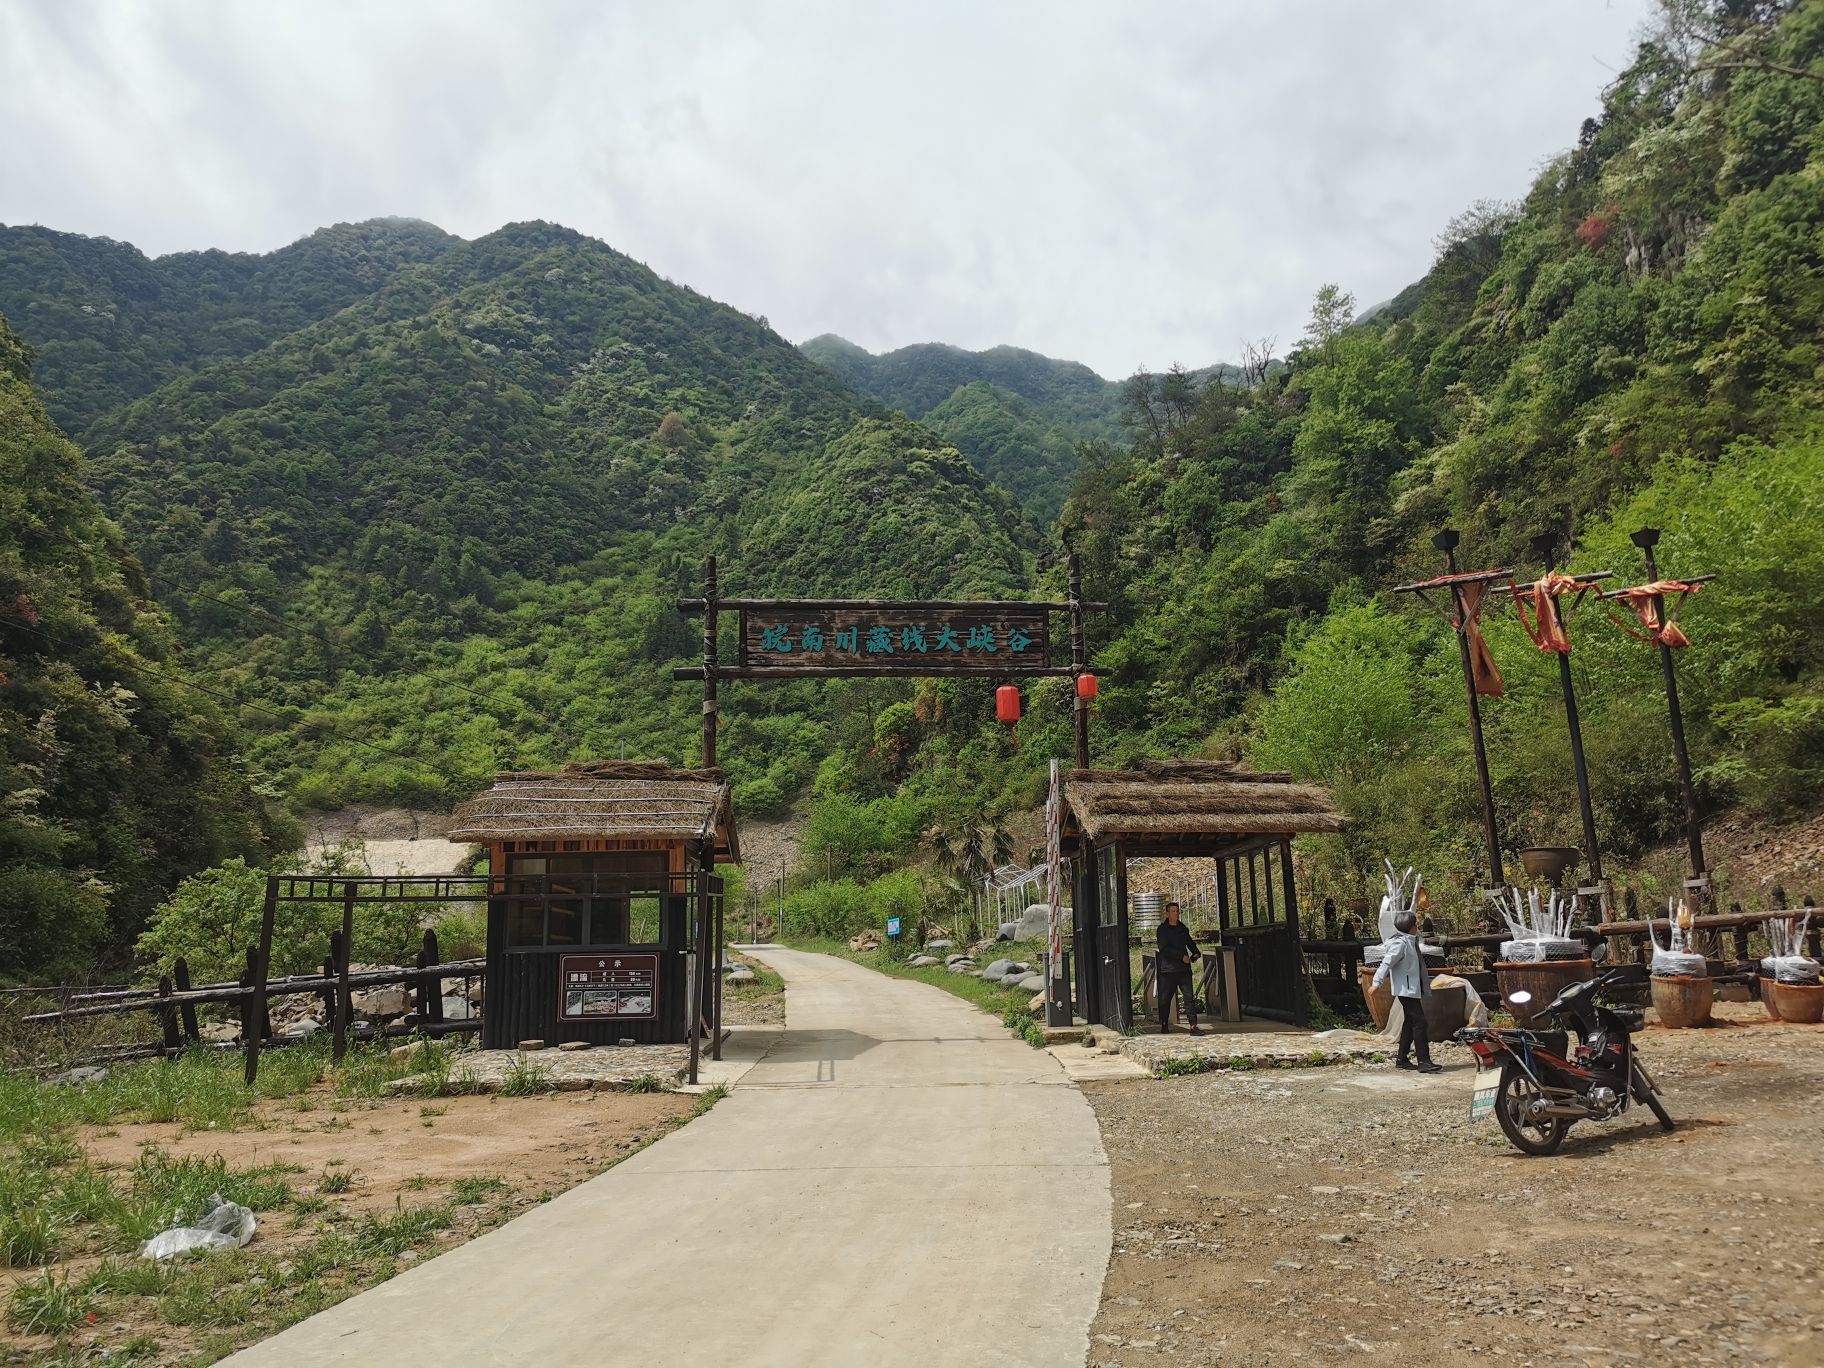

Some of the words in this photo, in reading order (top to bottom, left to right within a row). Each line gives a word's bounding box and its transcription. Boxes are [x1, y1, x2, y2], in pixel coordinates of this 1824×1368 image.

[762, 624, 1032, 654] 皖南川藏线大峡谷
